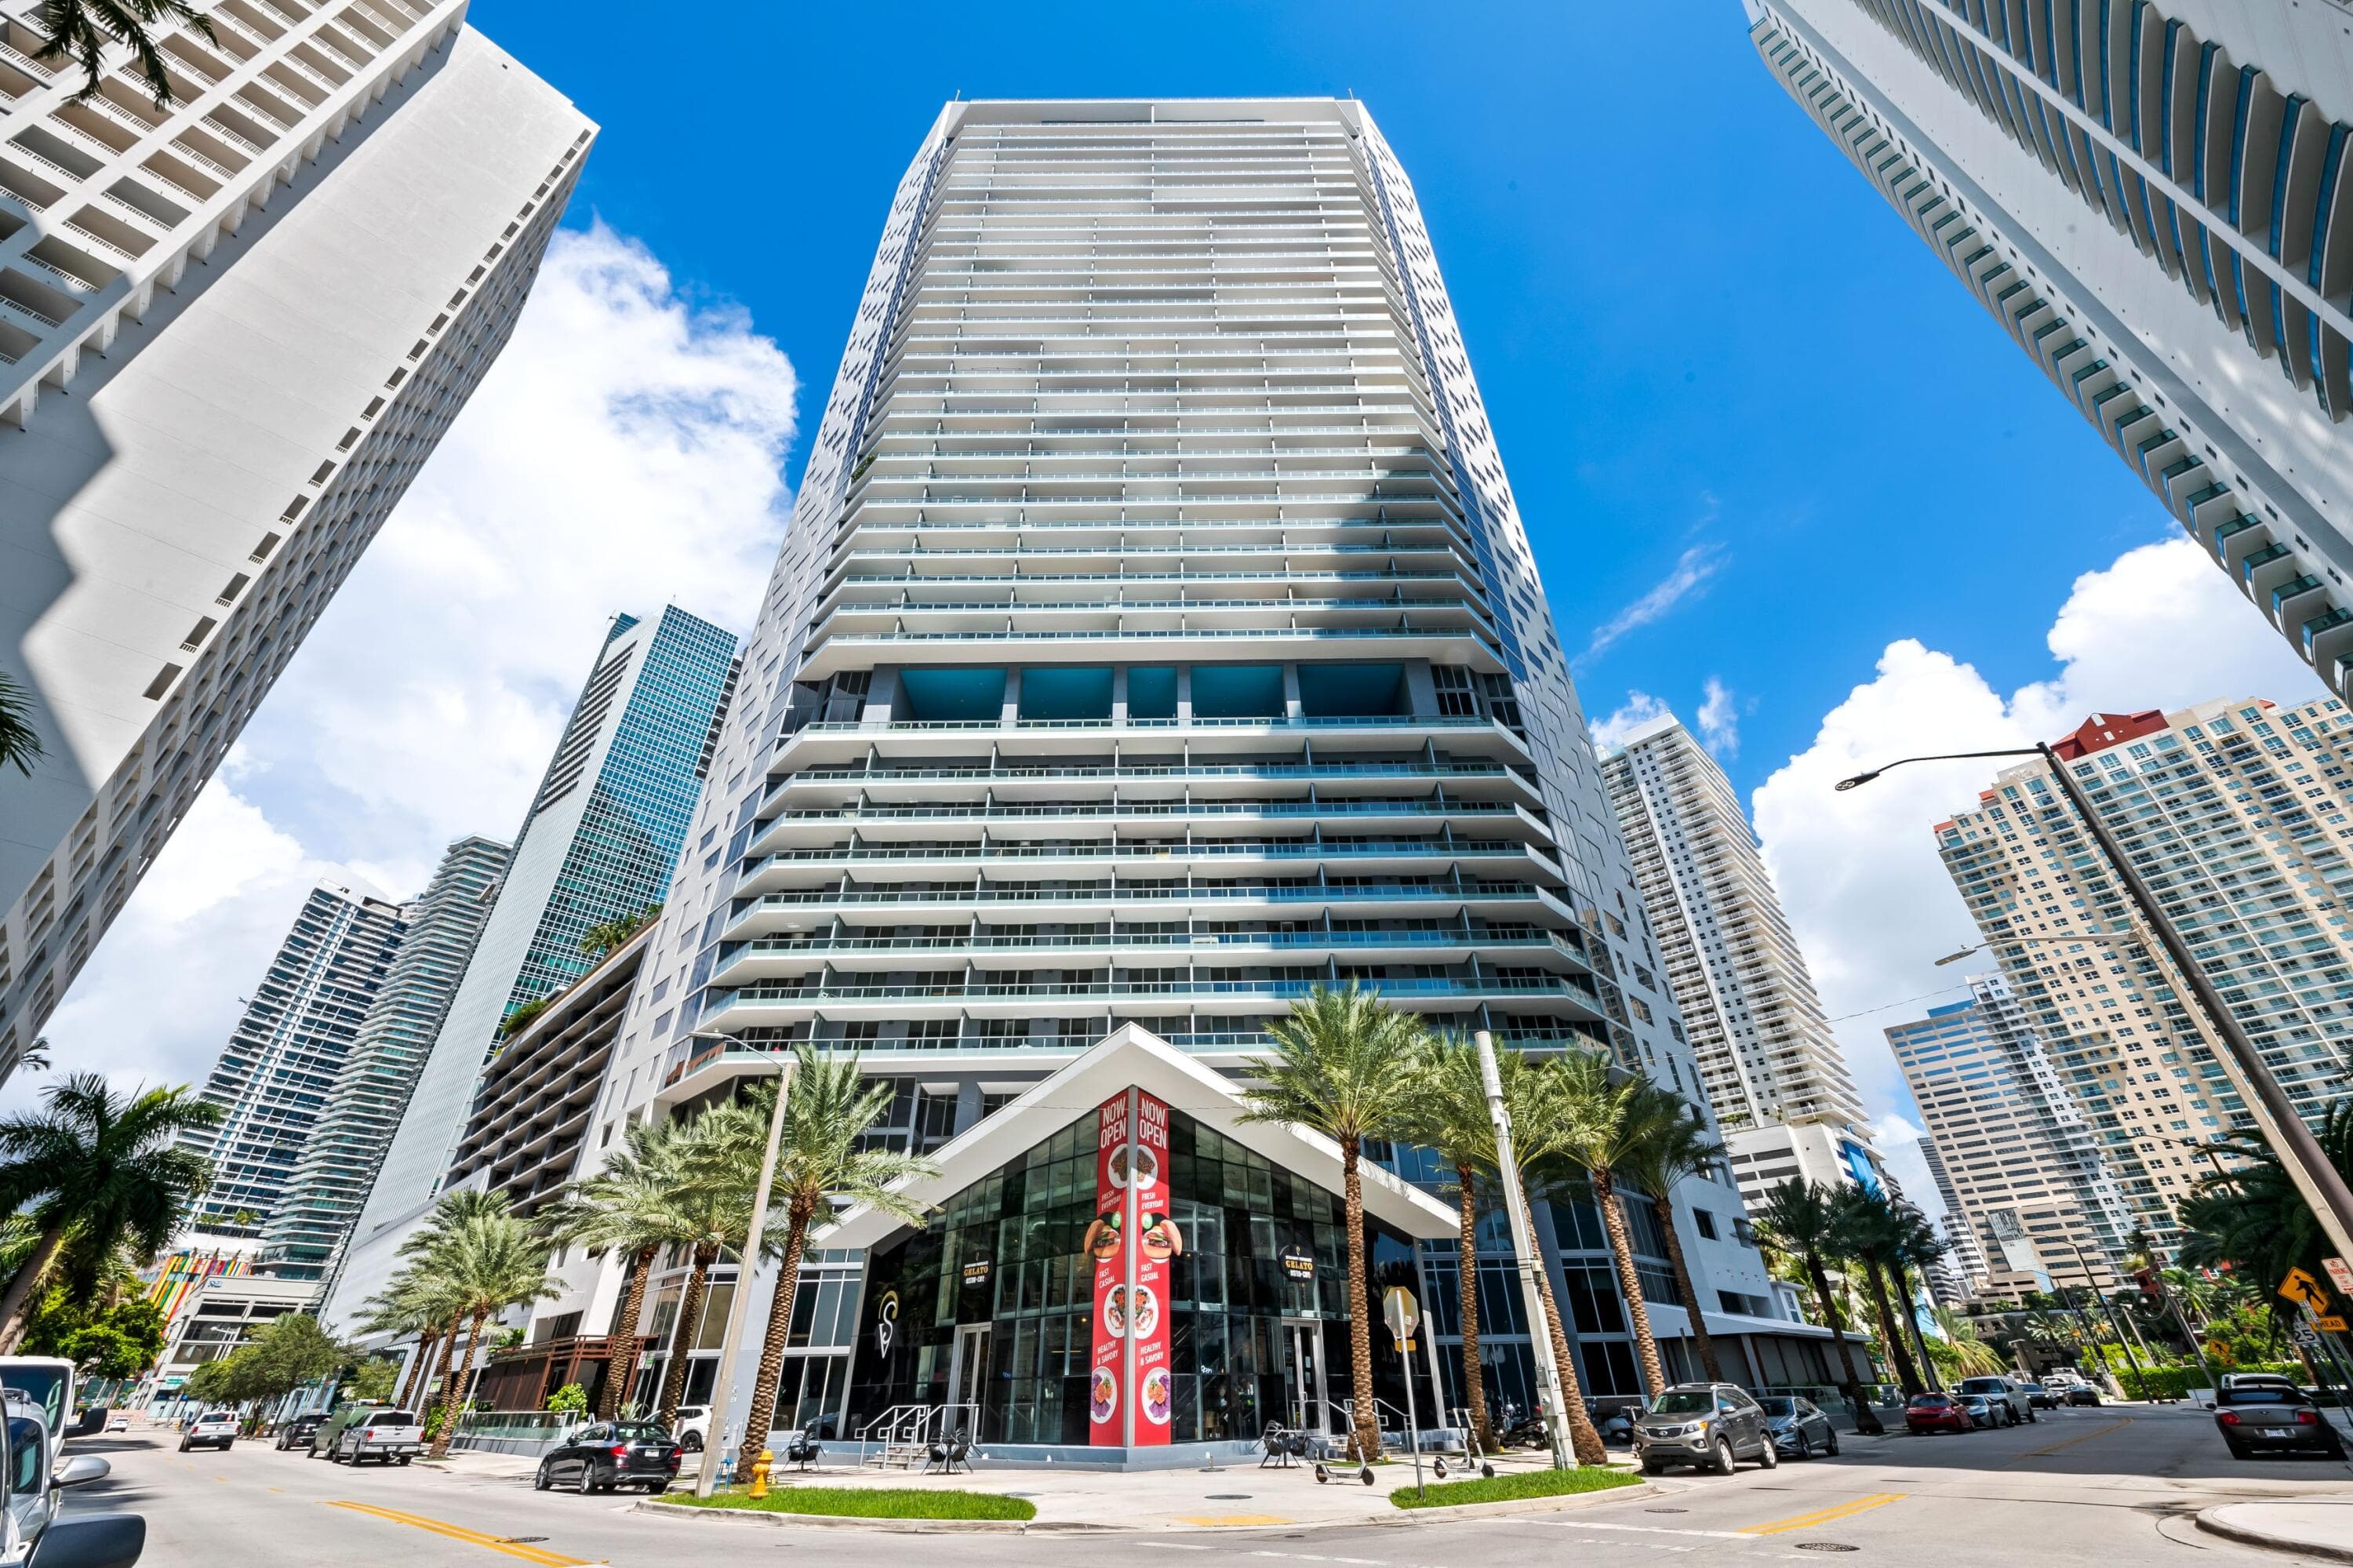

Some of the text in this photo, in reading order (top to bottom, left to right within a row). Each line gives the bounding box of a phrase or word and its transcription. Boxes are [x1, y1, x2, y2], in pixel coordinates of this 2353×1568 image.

[1103, 1097, 1126, 1127] NOW
[1141, 1097, 1166, 1127] NOW
[1100, 1117, 1126, 1149] OPEN
[1139, 1119, 1167, 1150] OPEN
[1101, 1189, 1115, 1202] FRESH
[1141, 1192, 1155, 1201] FRESH
[1101, 1194, 1122, 1211] EVERYDAY
[1141, 1199, 1163, 1210] EVERYDAY
[964, 1265, 988, 1276] GELATO
[1140, 1263, 1152, 1272] FAST
[1286, 1260, 1313, 1271] GELATO
[1099, 1268, 1110, 1279] FAST
[1140, 1271, 1158, 1282] CASUAL
[1099, 1275, 1115, 1289] CASUAL
[2293, 1329, 2316, 1342] 25
[1097, 1340, 1116, 1355] HEALTHY
[1140, 1341, 1162, 1355] HEALTHY
[1101, 1349, 1118, 1364] SAVORY
[1145, 1352, 1164, 1365] SAVORY
